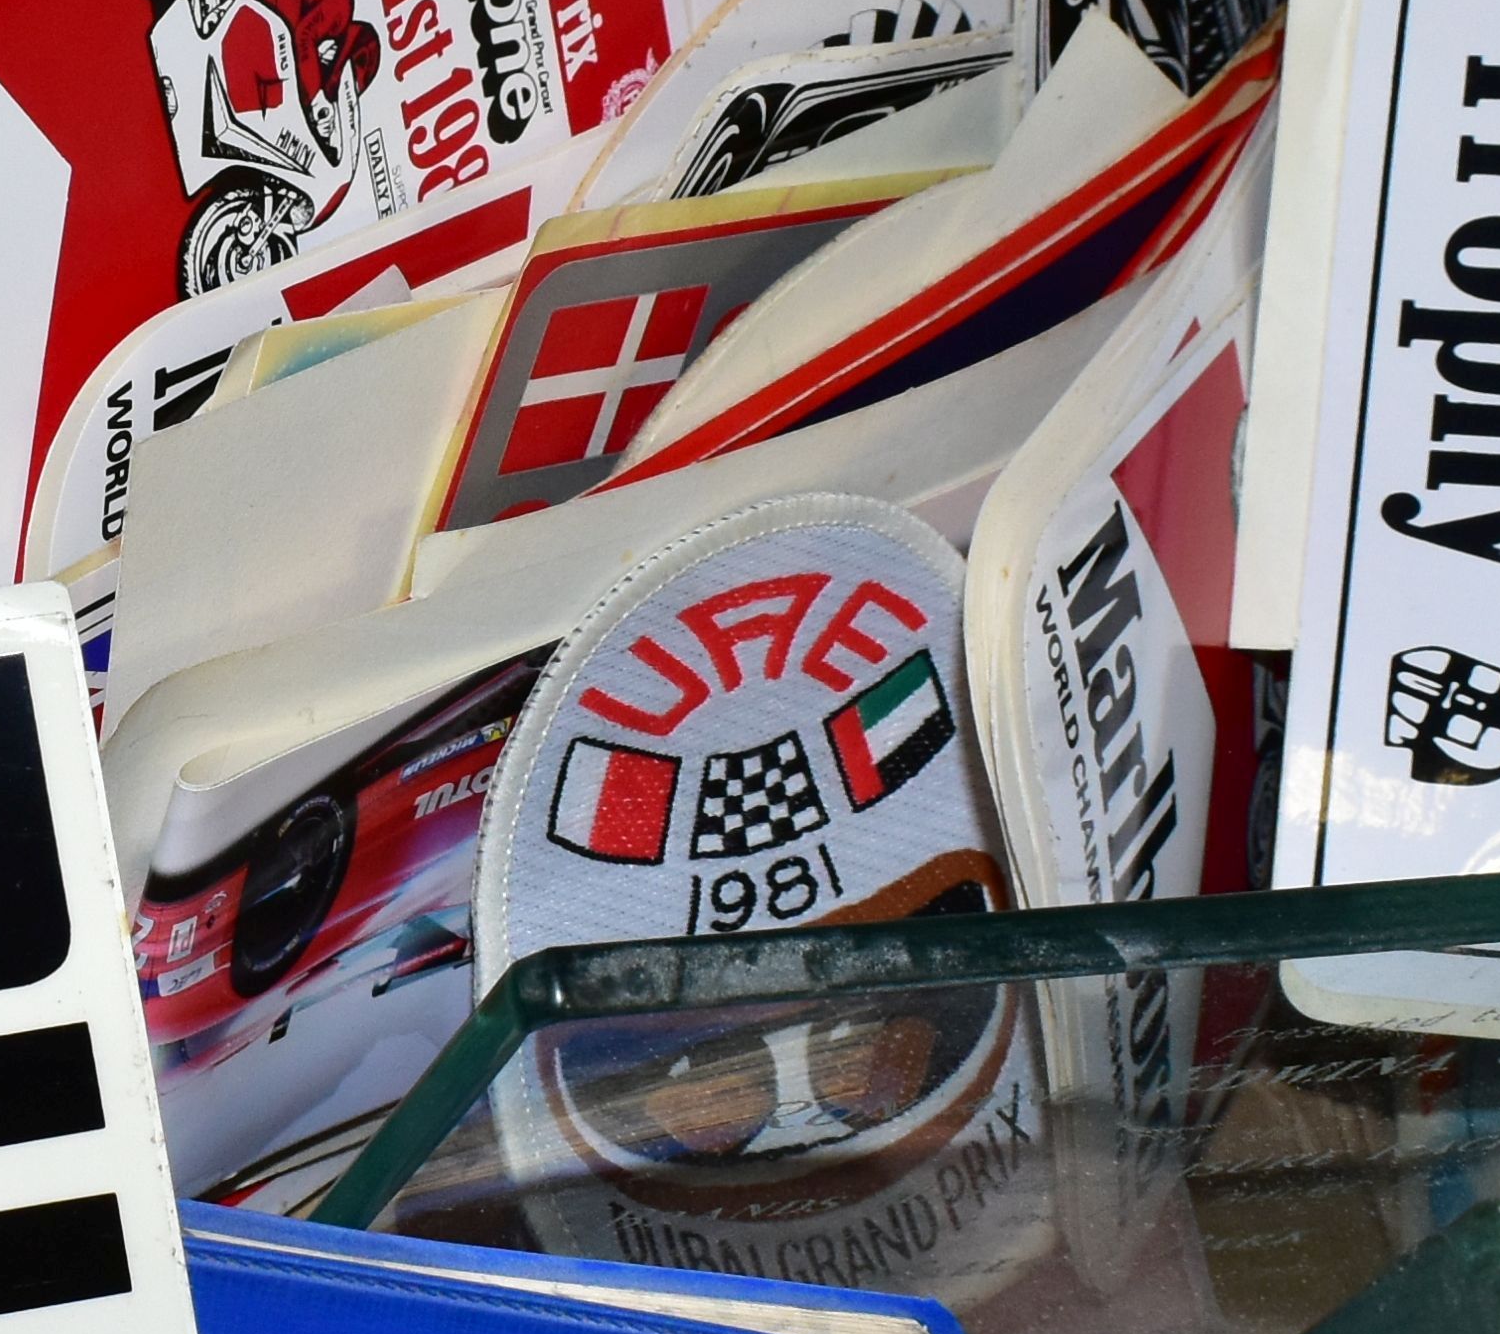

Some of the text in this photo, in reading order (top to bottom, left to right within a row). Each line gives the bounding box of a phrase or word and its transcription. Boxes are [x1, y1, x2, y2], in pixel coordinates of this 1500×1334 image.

[367, 138, 394, 219] DAILY E
[391, 165, 409, 212] SUPPO
[400, 67, 490, 203] 198
[100, 380, 136, 545] WORLD
[577, 571, 929, 737] UAE
[413, 765, 498, 821] OTUL
[1035, 583, 1101, 904] WORLD CHAMP
[686, 842, 845, 936] 1981
[776, 1192, 939, 1289] GRAND
[937, 1079, 1032, 1232] PRIX
